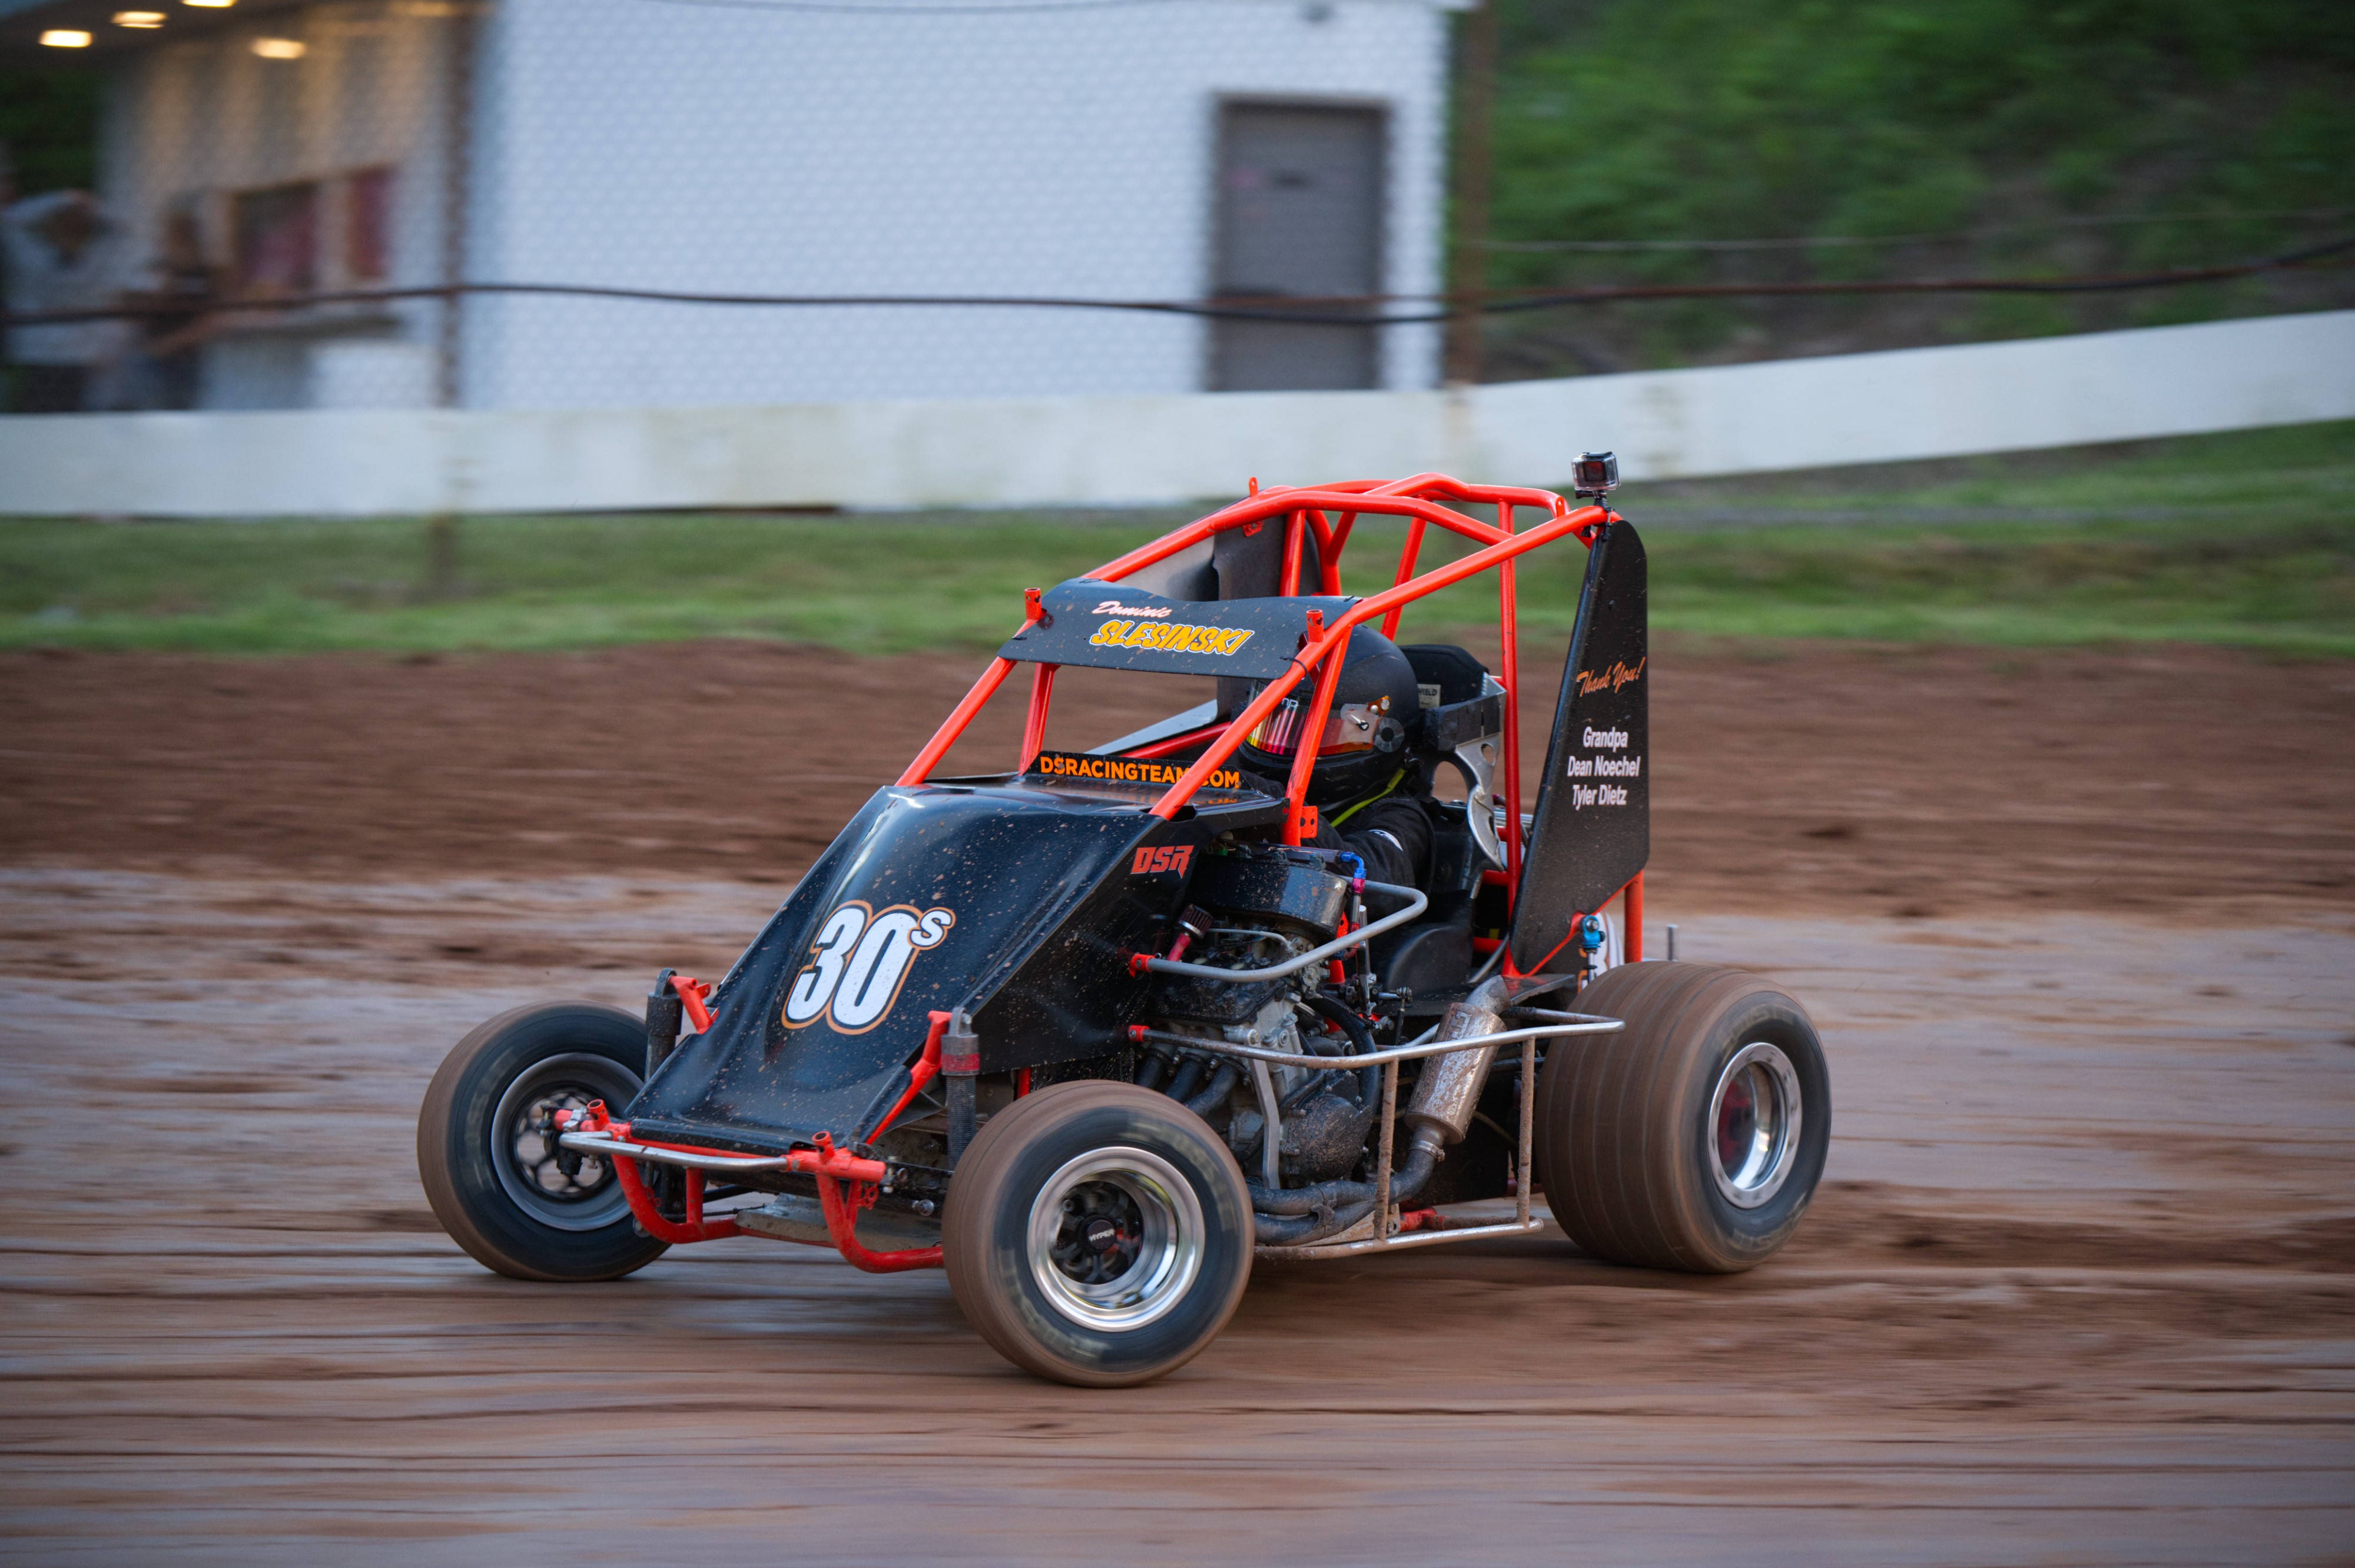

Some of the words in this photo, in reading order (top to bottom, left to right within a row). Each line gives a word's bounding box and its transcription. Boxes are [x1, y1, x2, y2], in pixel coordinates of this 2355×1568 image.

[1092, 600, 1172, 618] Dominic
[1089, 619, 1255, 656] SLESINSKI
[1576, 665, 1612, 697] Thank
[1613, 656, 1646, 693] You!
[1583, 726, 1628, 753] Grandpa
[1567, 755, 1593, 777] Dean
[1594, 755, 1641, 777] Noechel
[1573, 784, 1598, 811] Tyler
[1598, 783, 1628, 805] Dietz
[1130, 845, 1195, 879] DSR
